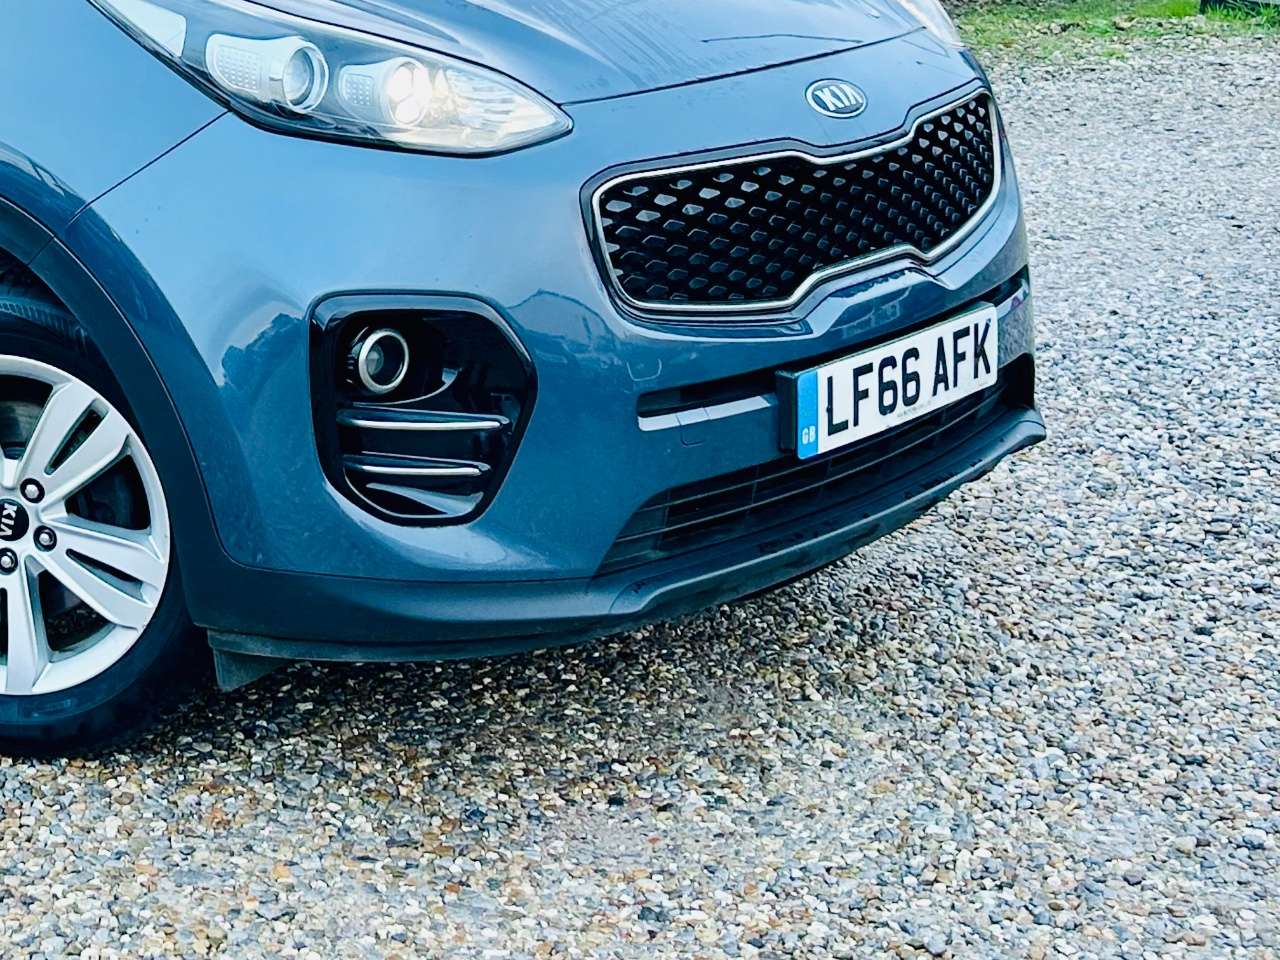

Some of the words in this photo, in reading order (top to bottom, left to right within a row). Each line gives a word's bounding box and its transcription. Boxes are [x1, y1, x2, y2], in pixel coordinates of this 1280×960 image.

[814, 83, 863, 112] KIA
[826, 347, 920, 436] LF66
[932, 318, 992, 398] AFK
[802, 425, 816, 445] GB
